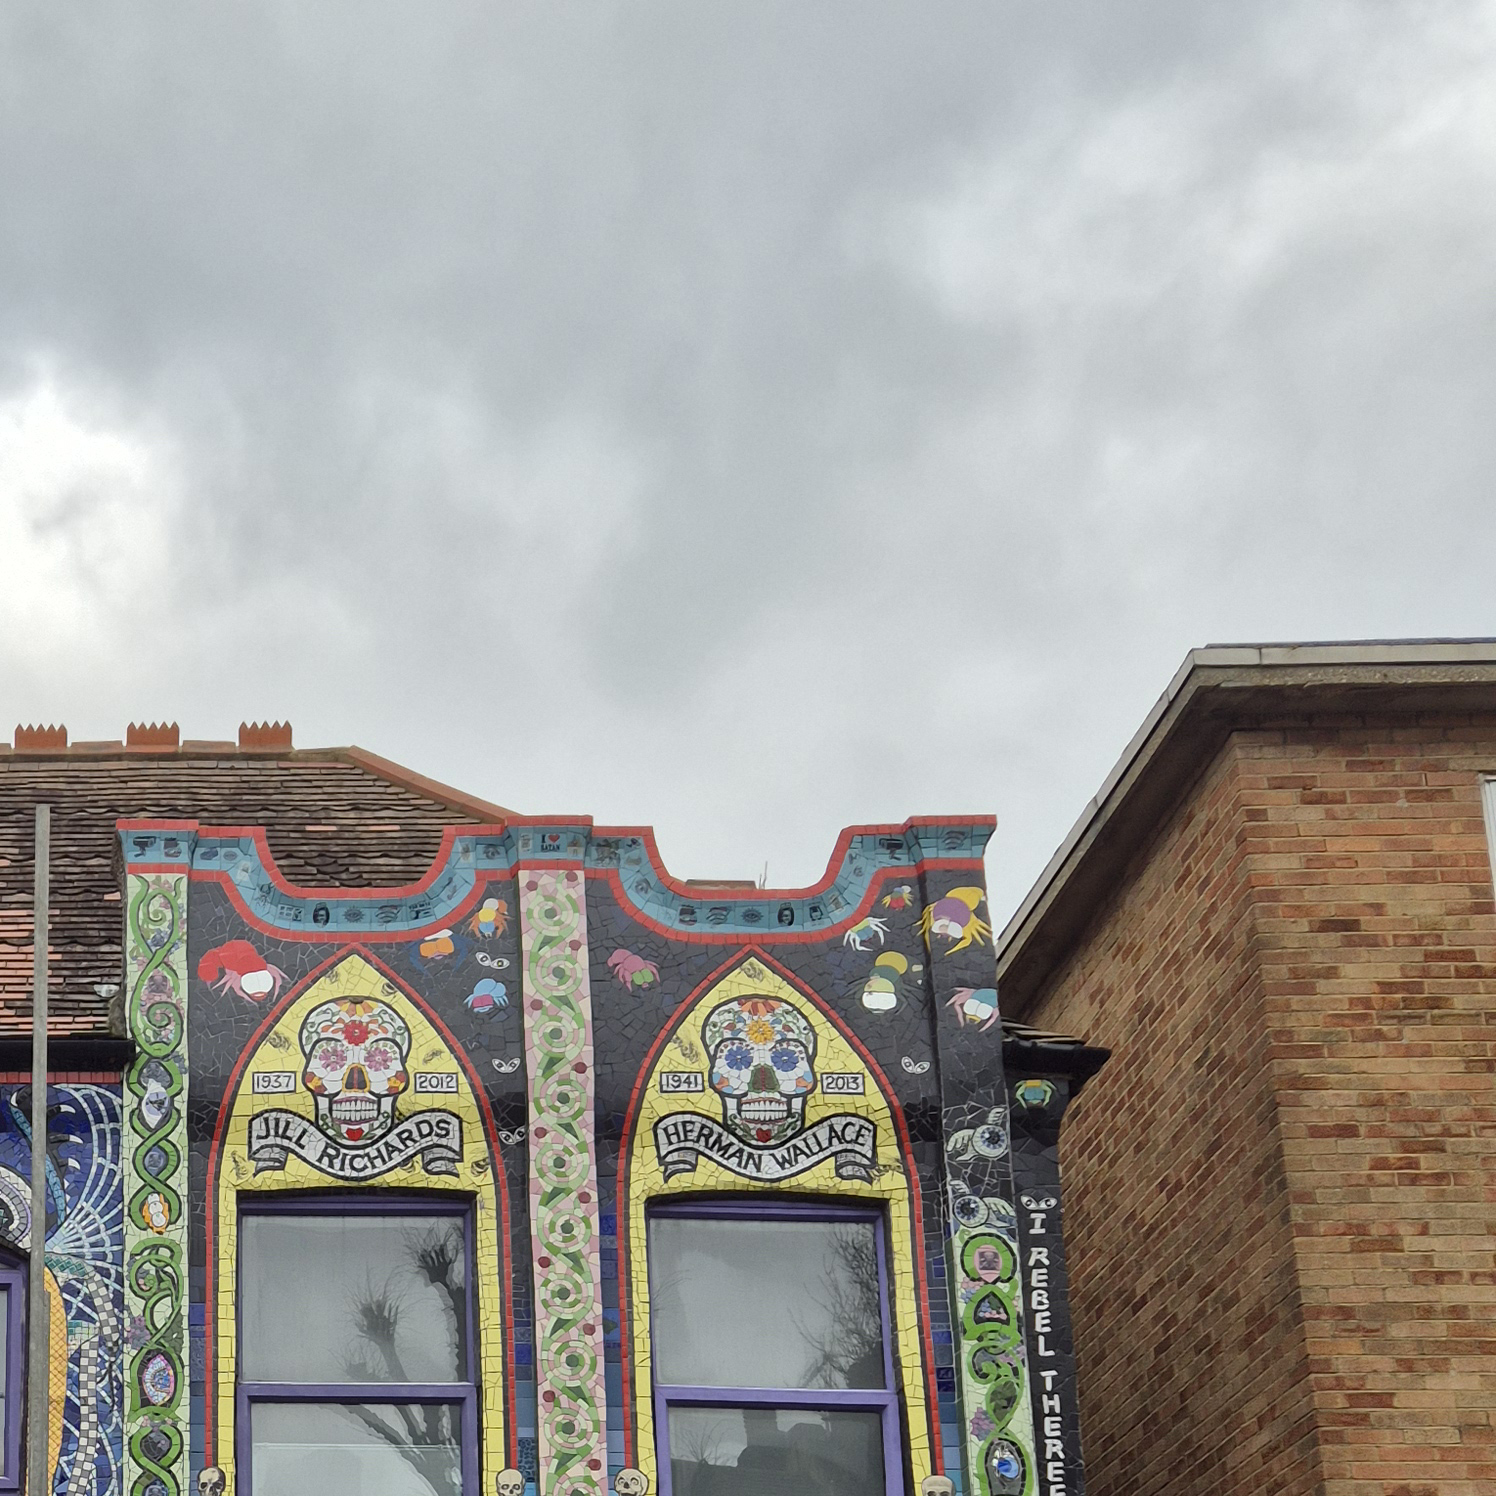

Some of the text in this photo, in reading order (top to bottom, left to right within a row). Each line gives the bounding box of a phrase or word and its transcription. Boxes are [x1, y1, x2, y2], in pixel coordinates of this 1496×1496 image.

[256, 1075, 292, 1090] 1937
[418, 1075, 455, 1091] 2012
[665, 1075, 699, 1089] 1941
[826, 1076, 860, 1091] 2013
[256, 1116, 452, 1172] JILL RICHARDS
[663, 1121, 871, 1172] HERMAN WALLACE
[1029, 1212, 1047, 1234] I
[1028, 1247, 1056, 1358] REBEL
